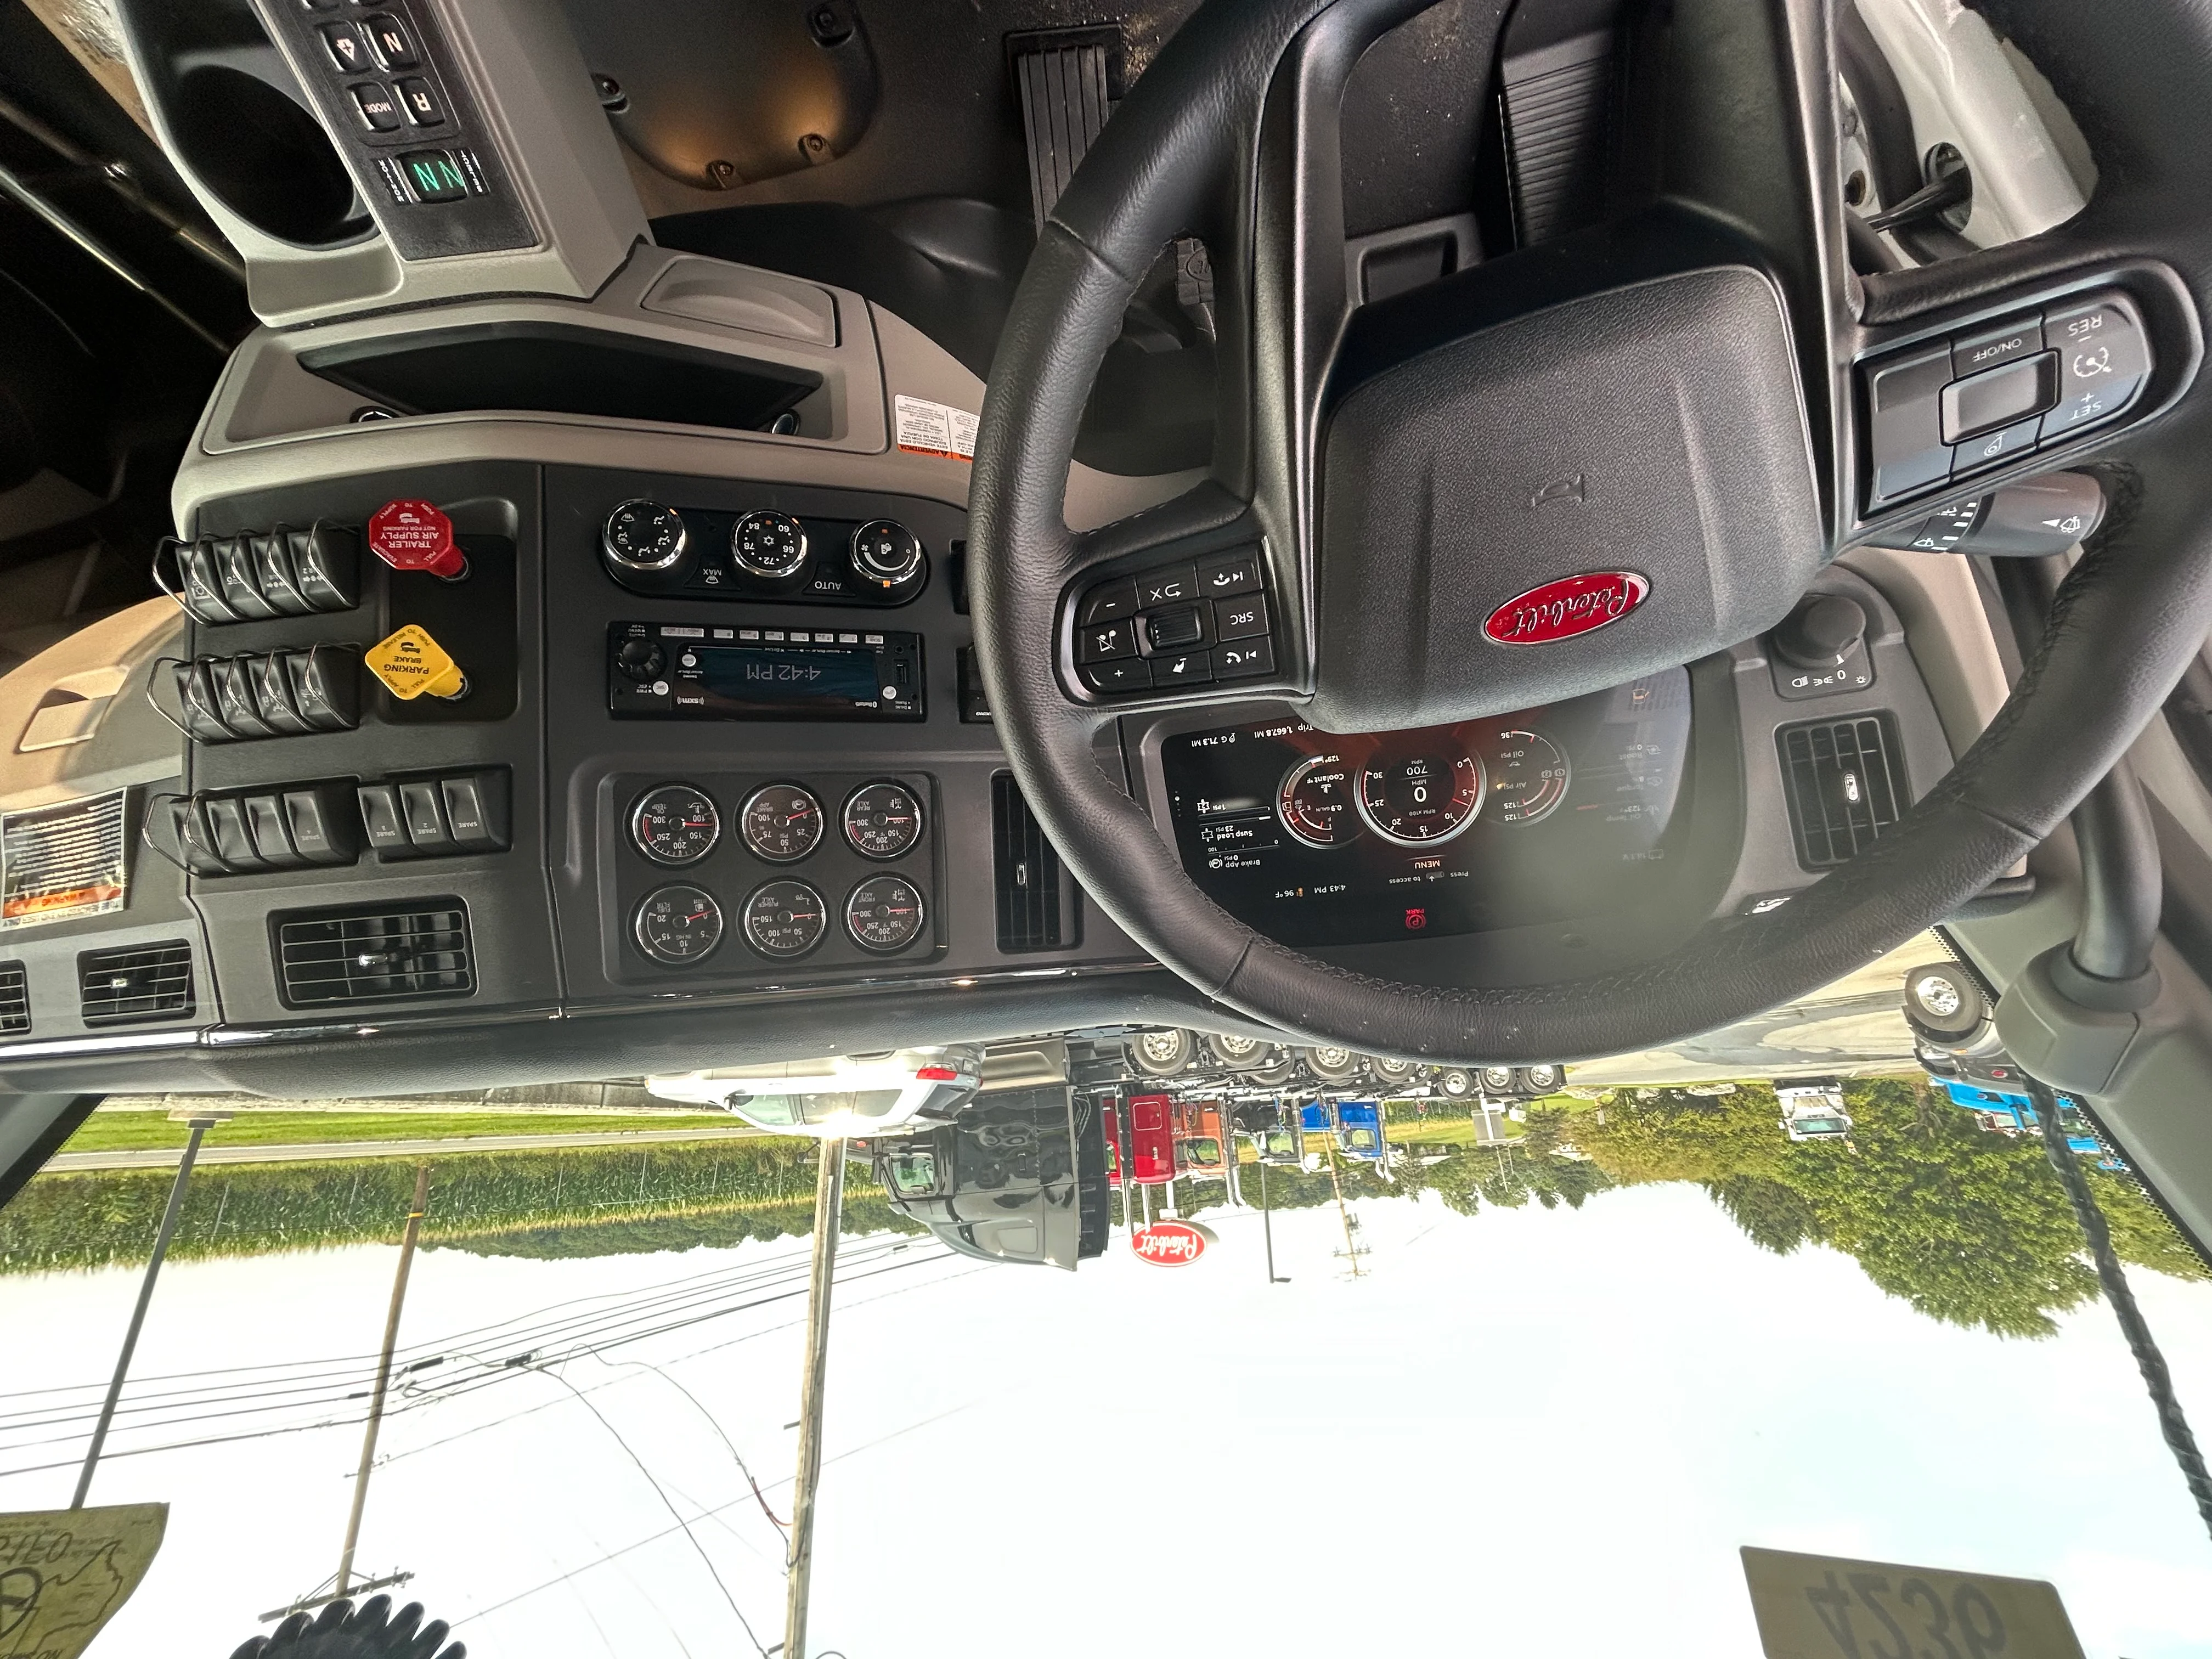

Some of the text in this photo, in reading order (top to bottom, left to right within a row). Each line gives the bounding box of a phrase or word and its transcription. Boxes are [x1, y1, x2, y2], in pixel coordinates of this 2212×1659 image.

[383, 32, 403, 52] N
[364, 102, 392, 114] MODE
[412, 93, 432, 111] R
[460, 150, 483, 193] SELECT
[378, 159, 404, 202] MONITOR
[2068, 314, 2102, 337] RES
[1972, 338, 2022, 362] ON/OFF
[2068, 400, 2102, 421] SET
[900, 444, 939, 454] ADVERTENCIA
[380, 532, 419, 540] SUPPLY
[372, 541, 397, 562] EVACUATE
[423, 551, 437, 561] PULL
[815, 581, 841, 590] AUTO
[1502, 579, 1628, 637] Peterbilt
[1229, 611, 1254, 625] SRC
[382, 633, 406, 649] RELEASE
[417, 634, 430, 646] PUSH
[383, 664, 429, 674] PARKING
[747, 664, 821, 681] 4:42 PM
[384, 674, 399, 687] APPLY
[411, 679, 425, 689] PULL
[1266, 726, 1293, 737] 1,667.8
[1297, 723, 1313, 732] Trip
[1203, 737, 1218, 745] 71.3
[1406, 765, 1427, 776] 700
[1314, 773, 1344, 783] Coolant
[1414, 786, 1427, 802] 0
[1217, 832, 1234, 840] Load
[1414, 860, 1441, 869] MENU
[1329, 884, 1346, 892] 4:43
[1136, 1234, 1197, 1260] Peterbilt
